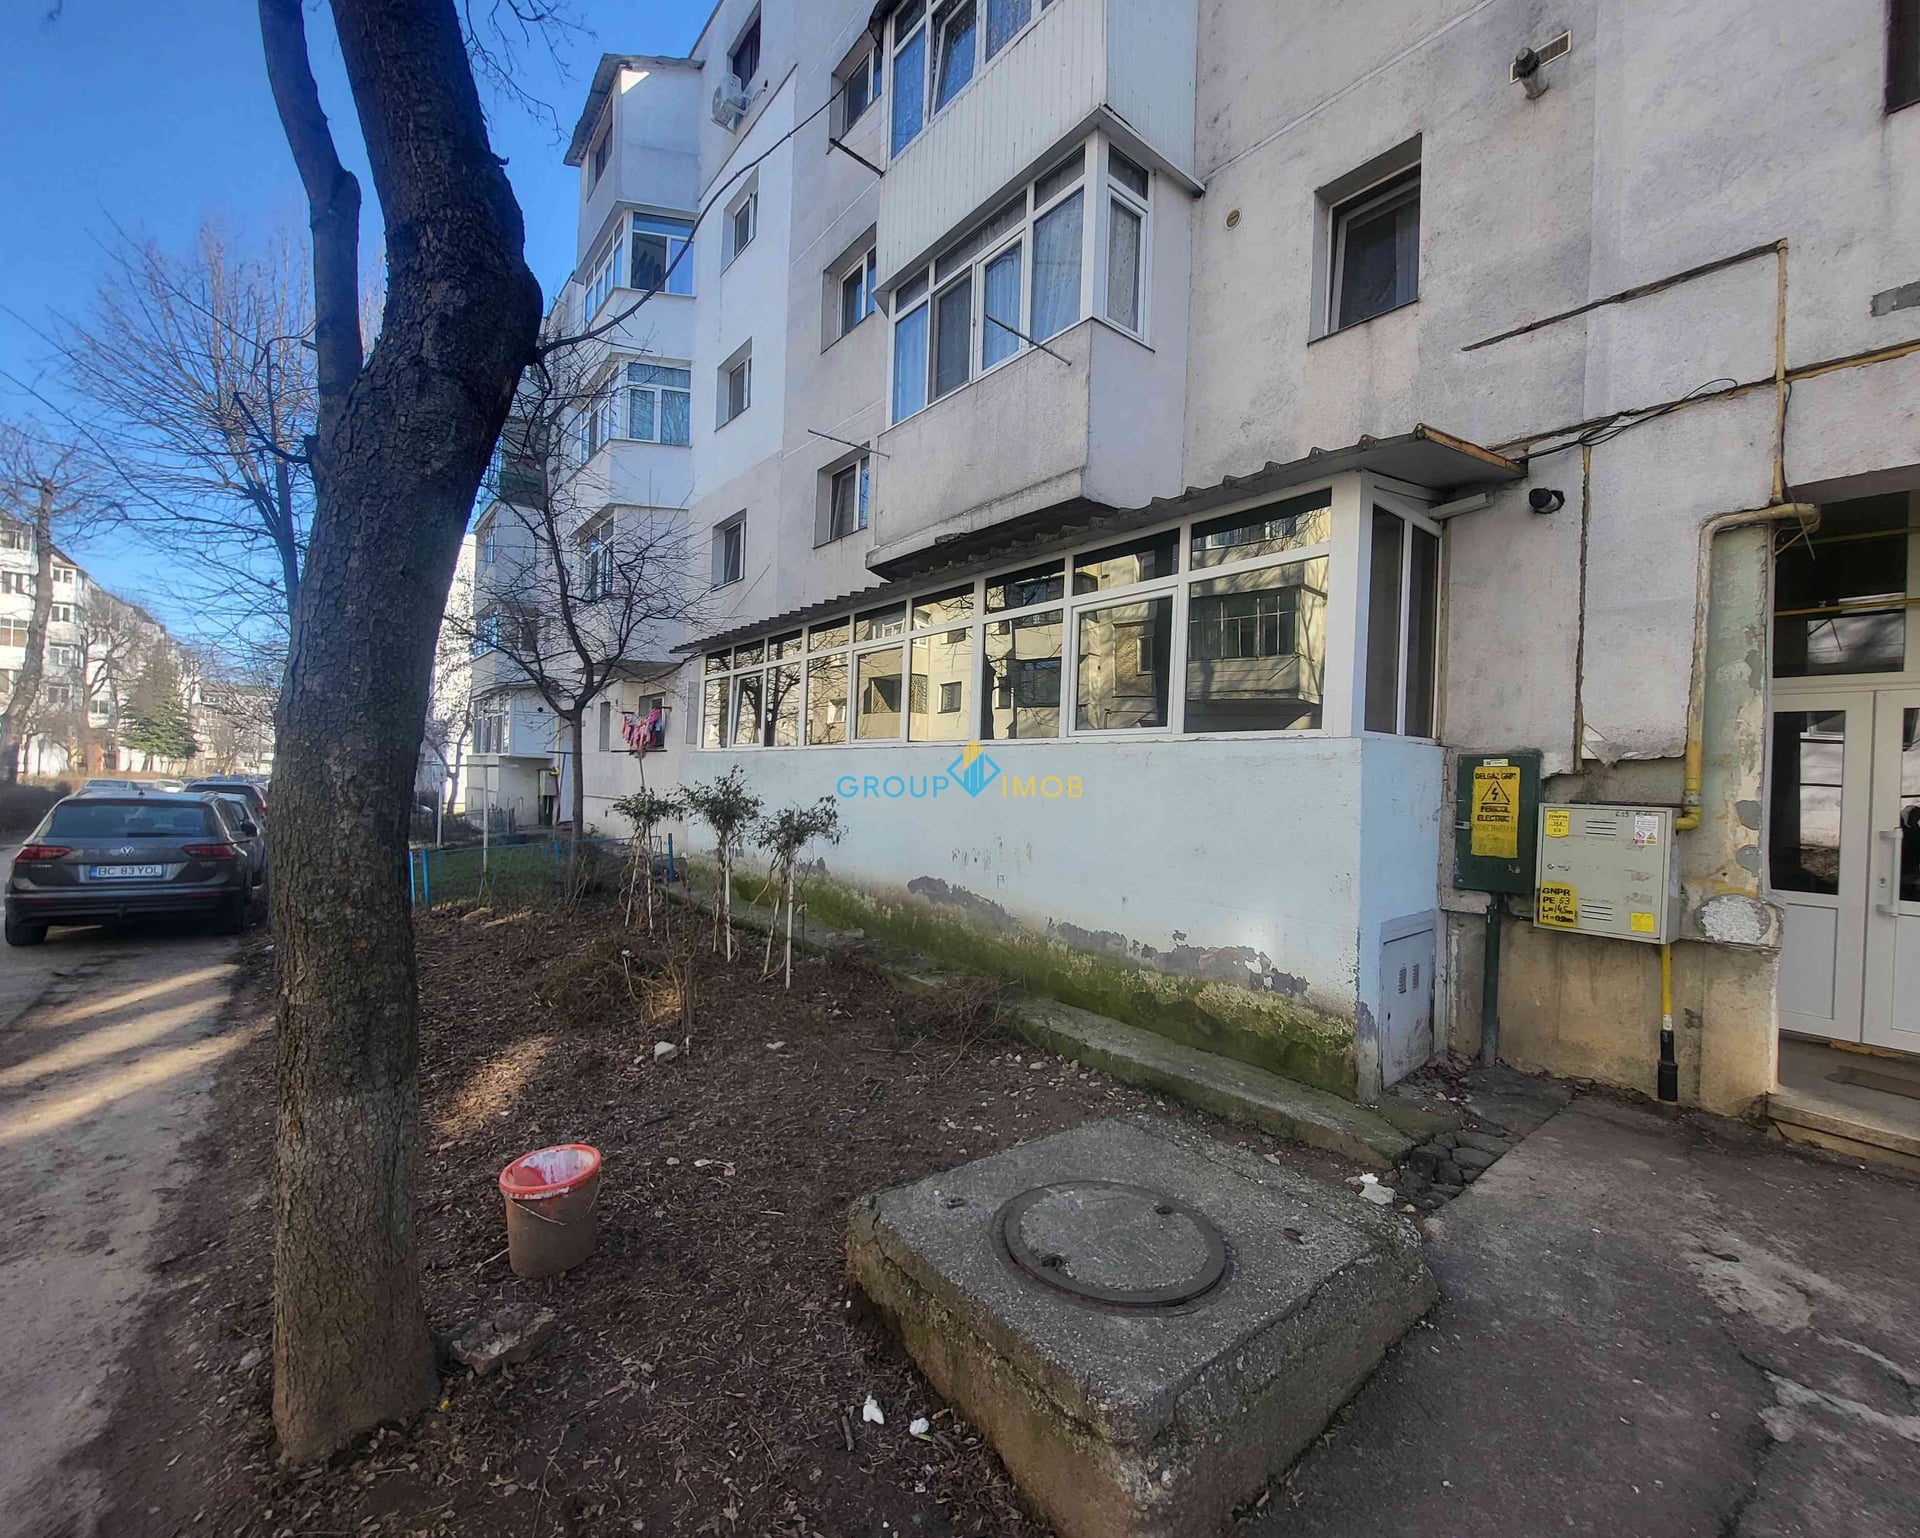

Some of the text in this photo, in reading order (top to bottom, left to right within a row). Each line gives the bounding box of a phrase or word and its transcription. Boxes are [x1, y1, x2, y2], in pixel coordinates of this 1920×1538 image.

[1477, 814, 1510, 822] ELECTRIC
[137, 866, 159, 875] YOL
[1542, 887, 1570, 896] GNPR
[1542, 896, 1571, 905] PE 63
